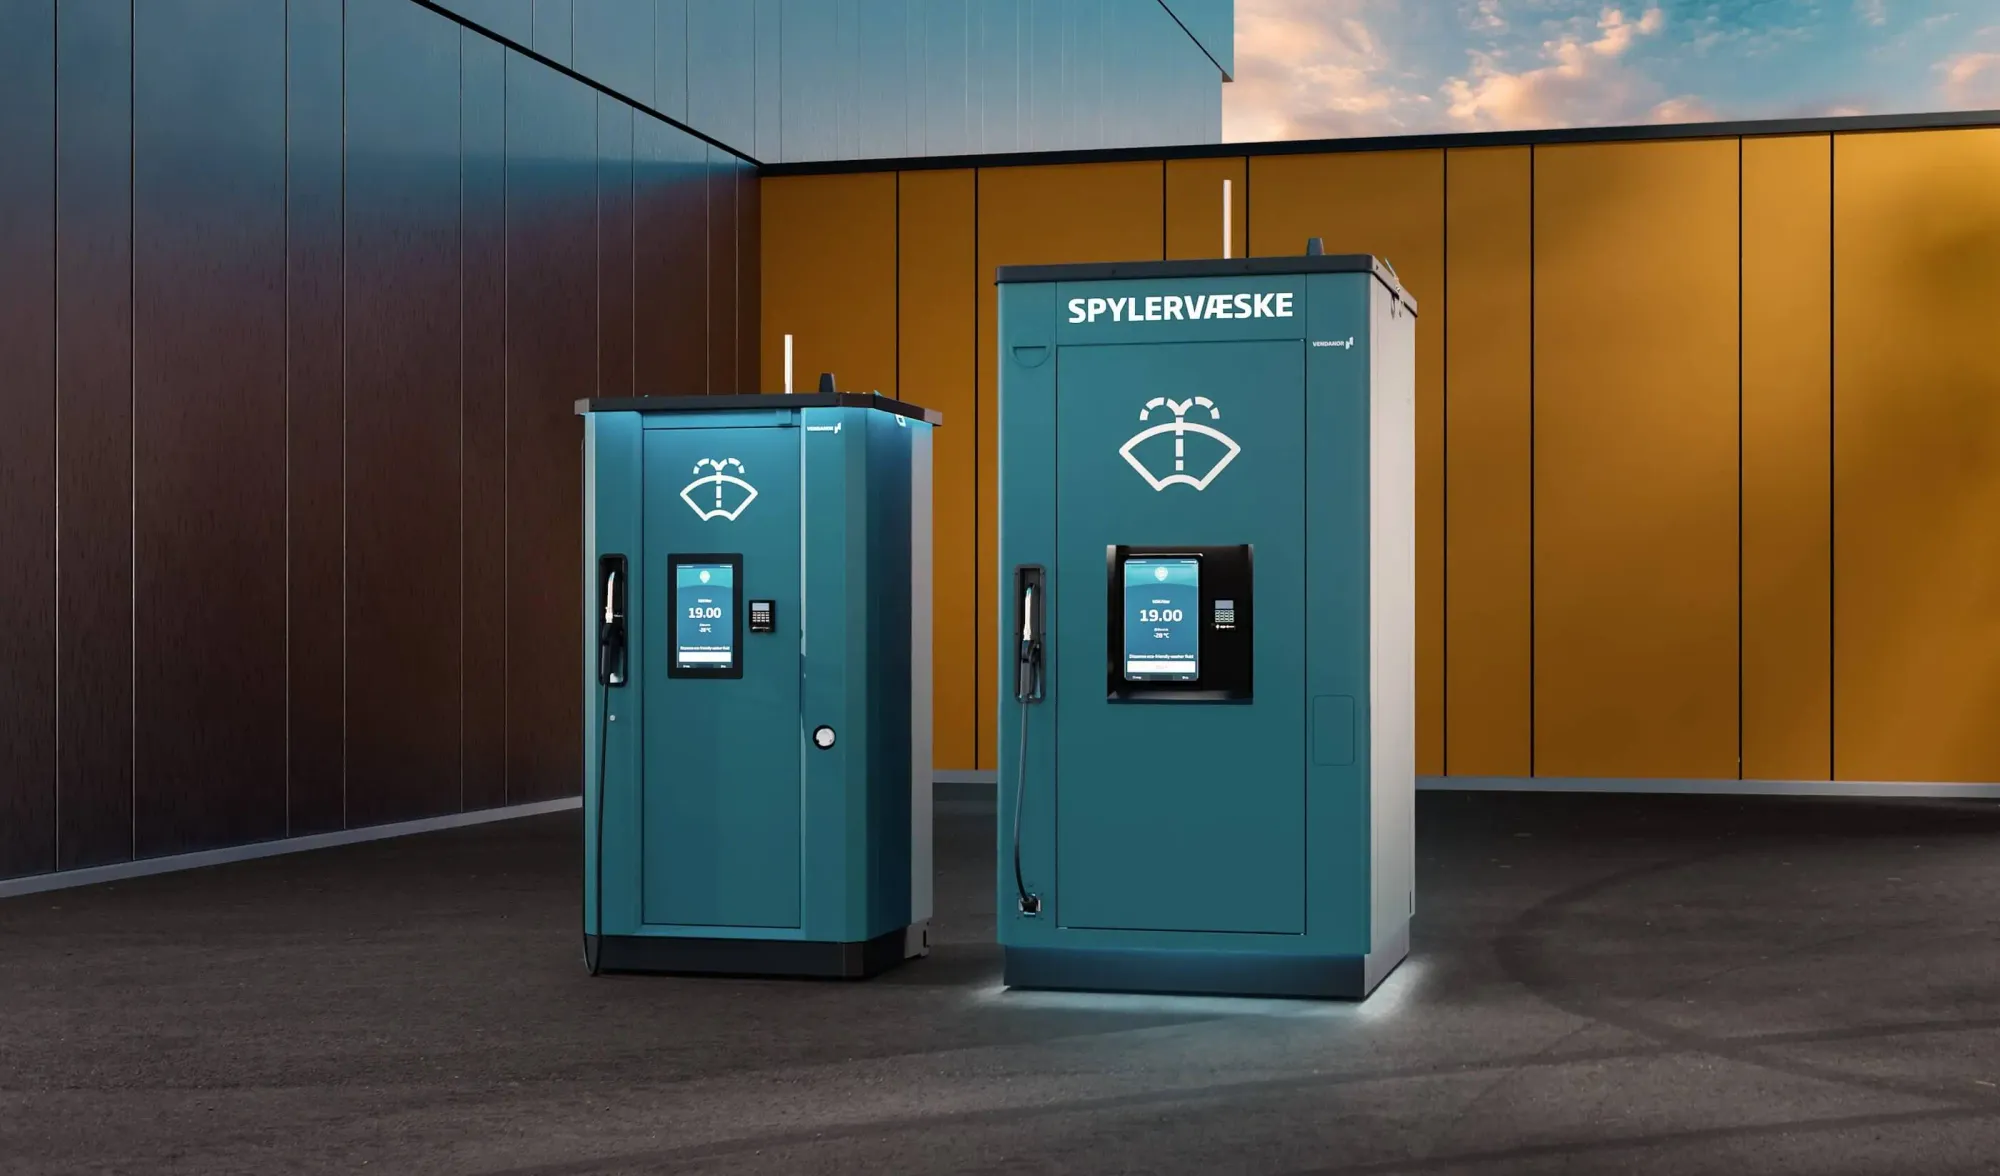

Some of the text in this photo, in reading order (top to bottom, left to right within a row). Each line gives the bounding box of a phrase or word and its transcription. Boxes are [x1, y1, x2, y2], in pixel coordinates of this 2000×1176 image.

[1068, 292, 1293, 324] SPYLERVÆSKE
[688, 607, 721, 619] 19.00
[1140, 609, 1183, 622] 19.00
